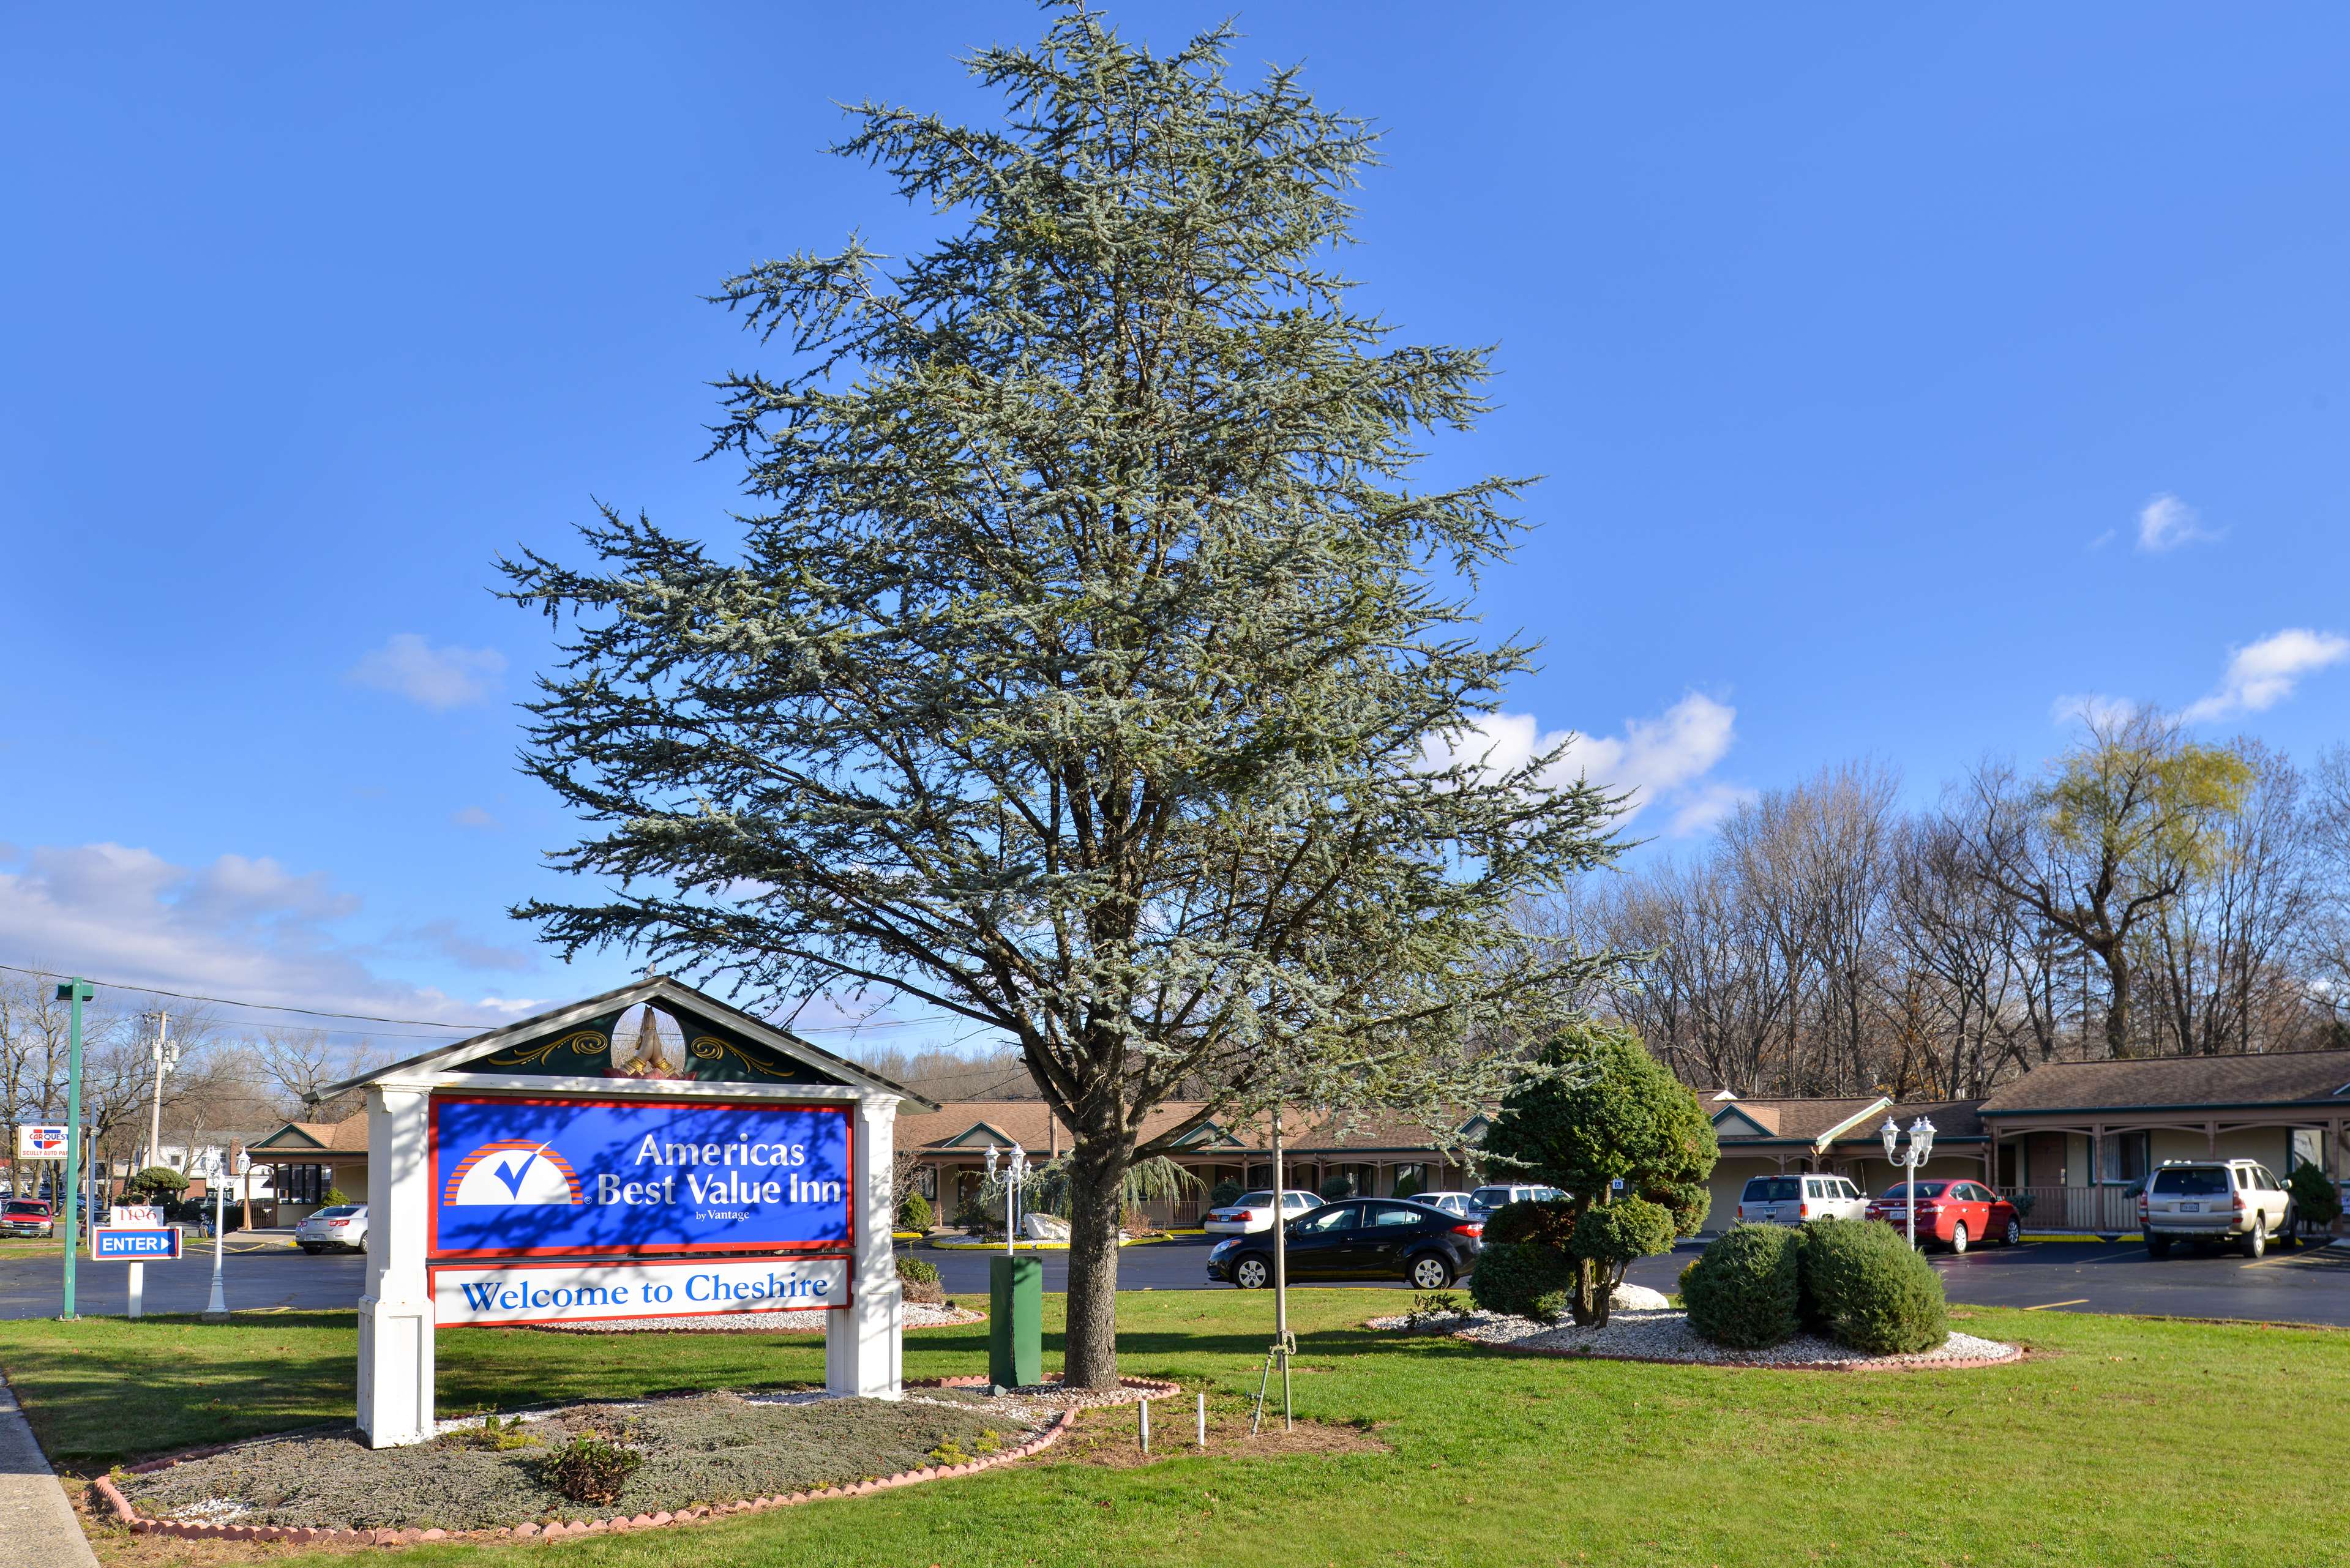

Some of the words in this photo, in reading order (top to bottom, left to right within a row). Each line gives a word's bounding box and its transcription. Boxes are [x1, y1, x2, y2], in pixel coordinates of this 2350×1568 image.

[635, 1133, 805, 1167] Americas
[598, 1174, 676, 1205] Best
[686, 1170, 781, 1204] Value
[790, 1172, 841, 1203] Inn
[119, 1208, 157, 1220] 1106
[695, 1211, 706, 1222] by
[707, 1209, 750, 1222] Vantage
[102, 1237, 158, 1252] ENTER
[460, 1280, 629, 1312] Welcome
[643, 1283, 673, 1303] to
[685, 1272, 828, 1301] Cheshire
